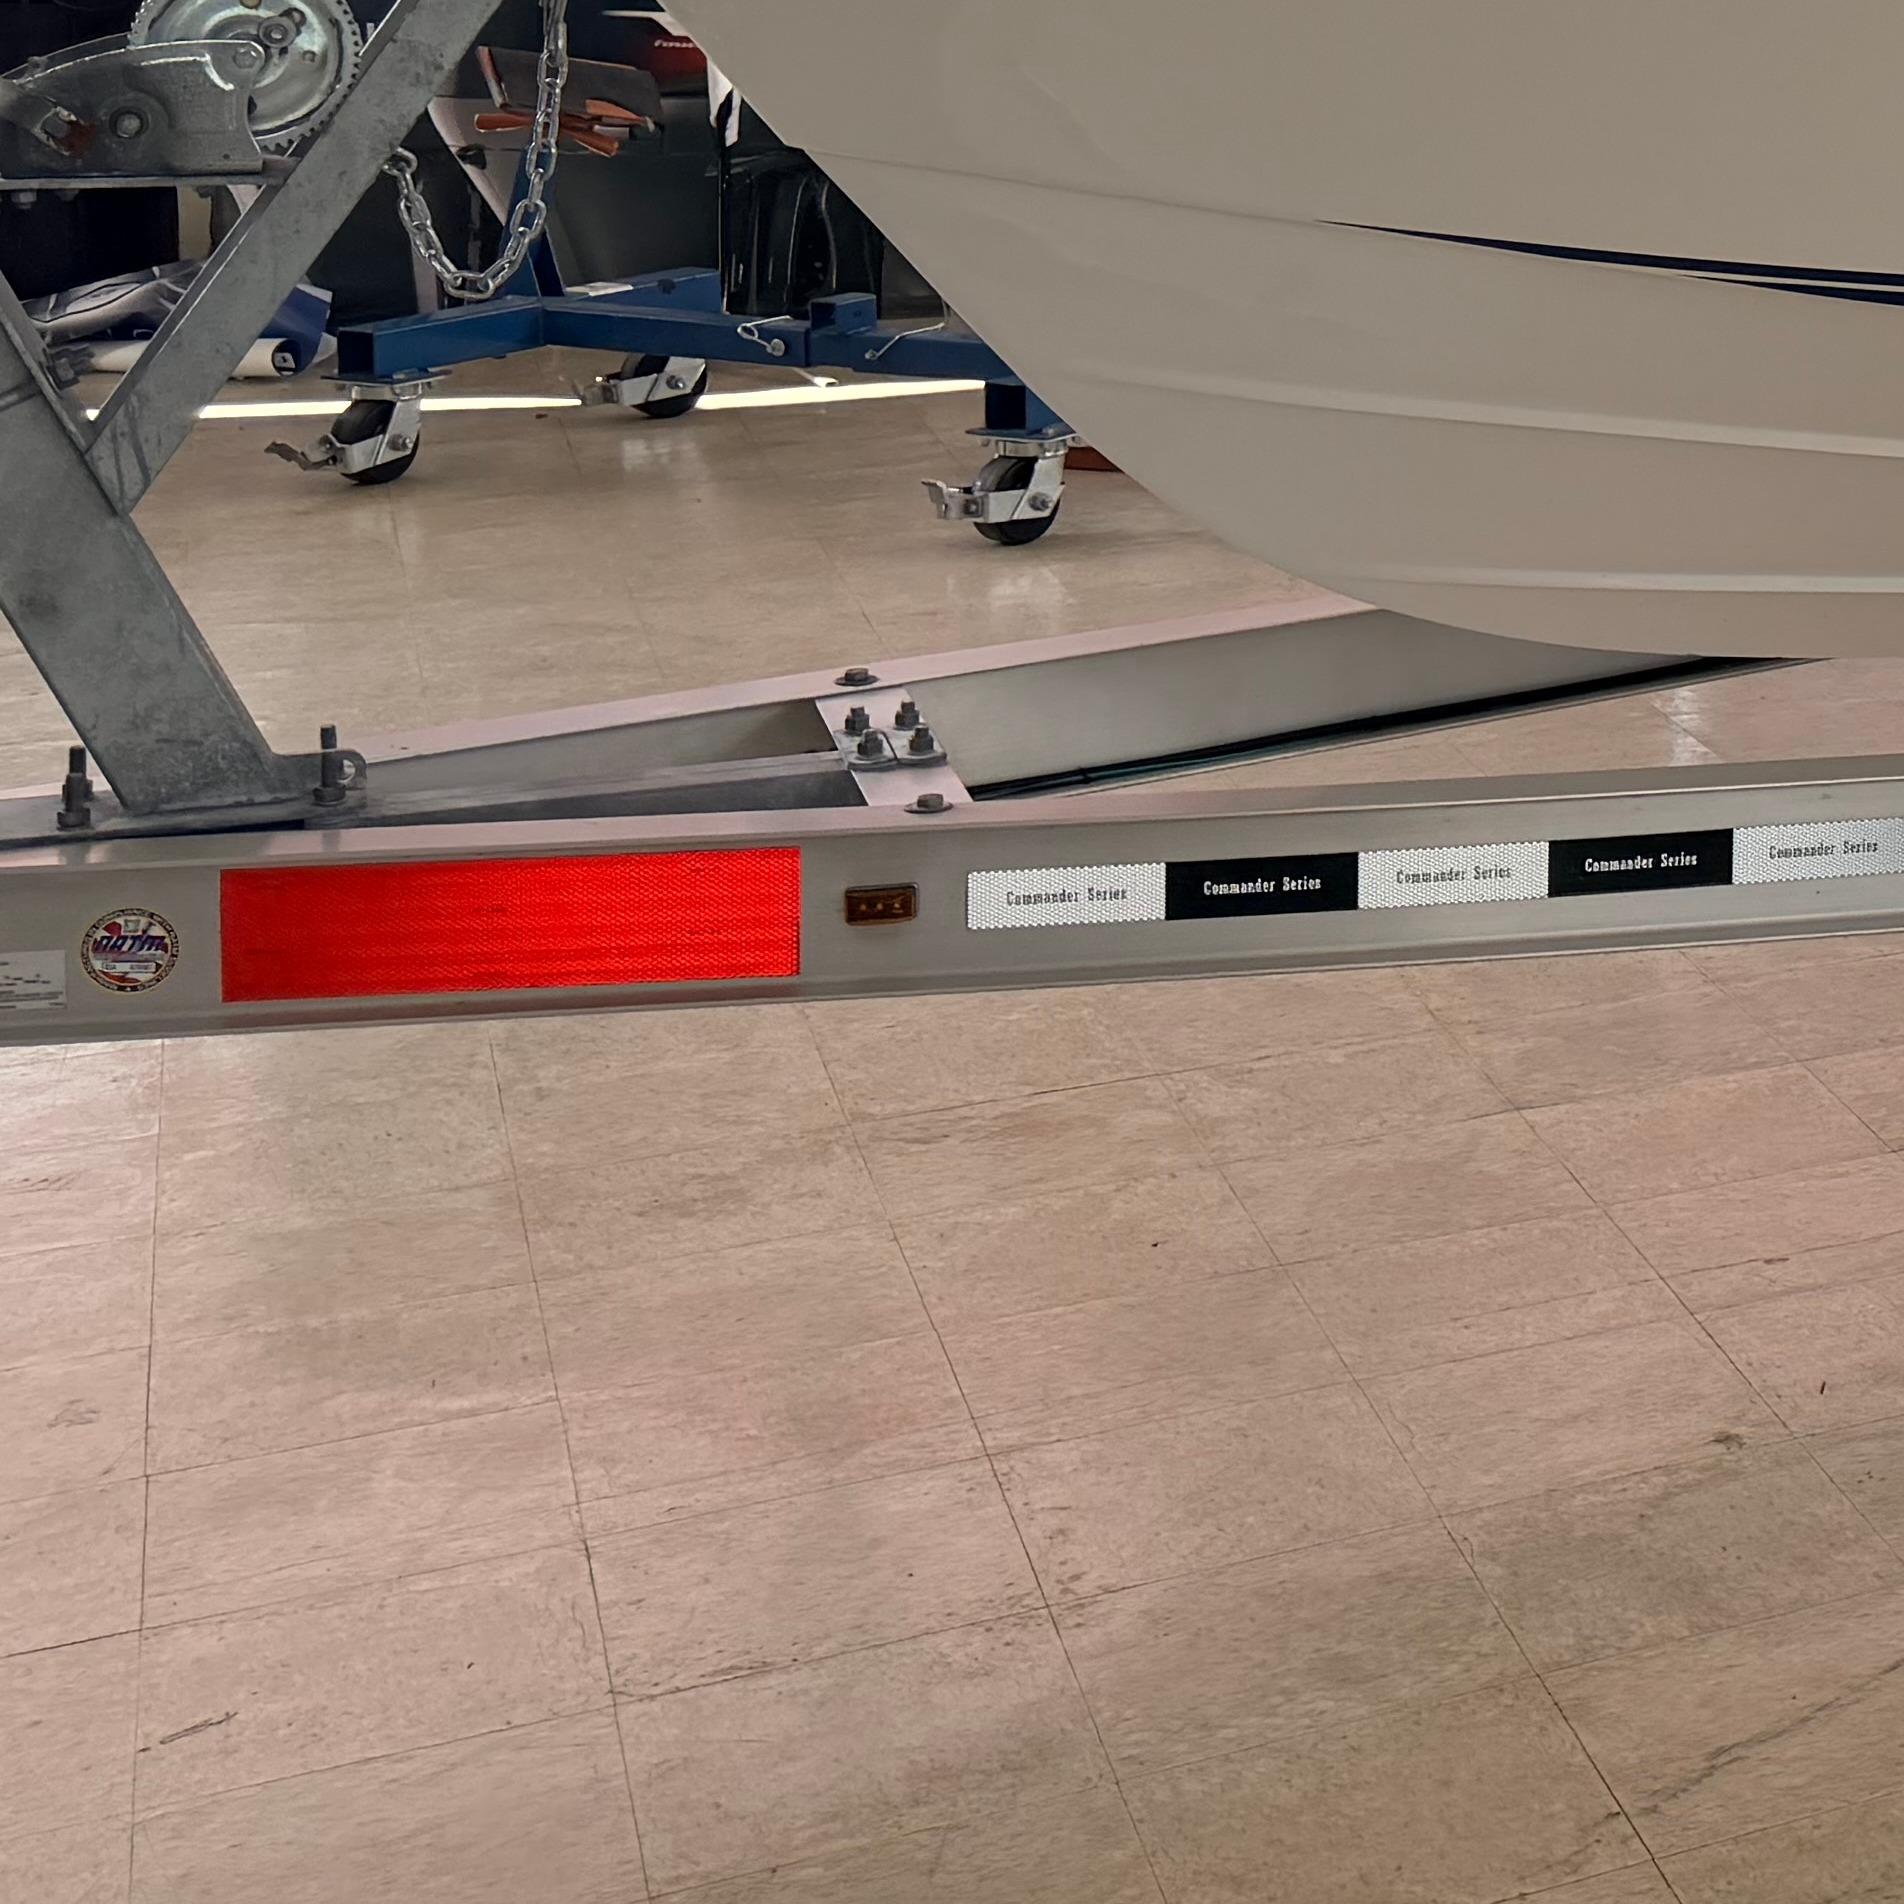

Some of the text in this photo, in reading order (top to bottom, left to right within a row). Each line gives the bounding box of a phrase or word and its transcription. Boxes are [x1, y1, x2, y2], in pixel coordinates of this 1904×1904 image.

[1769, 840, 1878, 860] Commander Series
[1585, 852, 1697, 872] Commander Series
[1396, 864, 1511, 885] Commander Series
[1203, 875, 1321, 895] Commander Series
[1006, 886, 1128, 906] Commander Series
